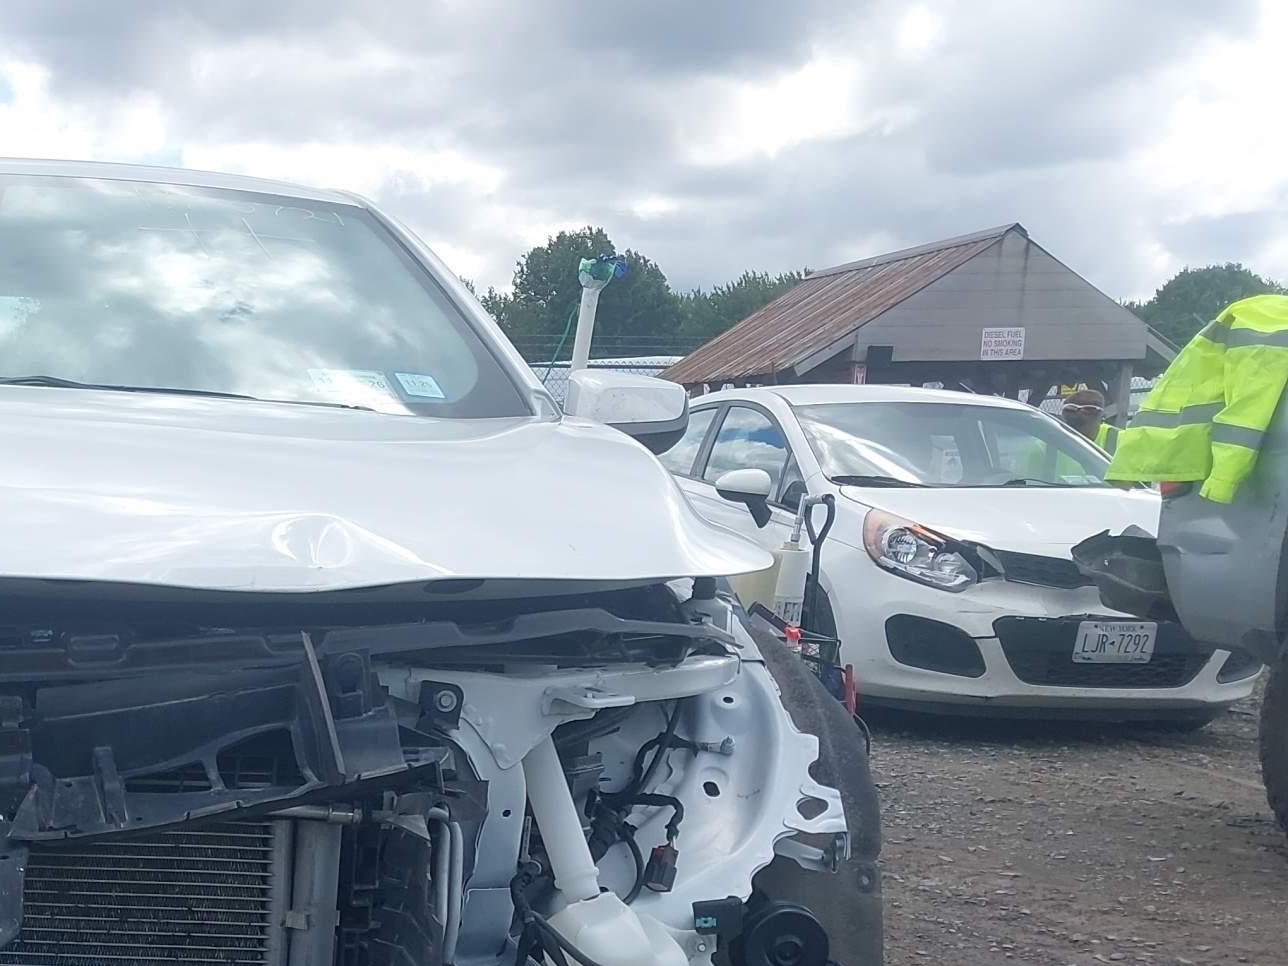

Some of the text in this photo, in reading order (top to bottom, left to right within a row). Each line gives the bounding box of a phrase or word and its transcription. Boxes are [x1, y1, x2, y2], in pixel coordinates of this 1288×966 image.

[984, 331, 1006, 339] DIESEL
[983, 340, 1022, 348] NO SMOKING
